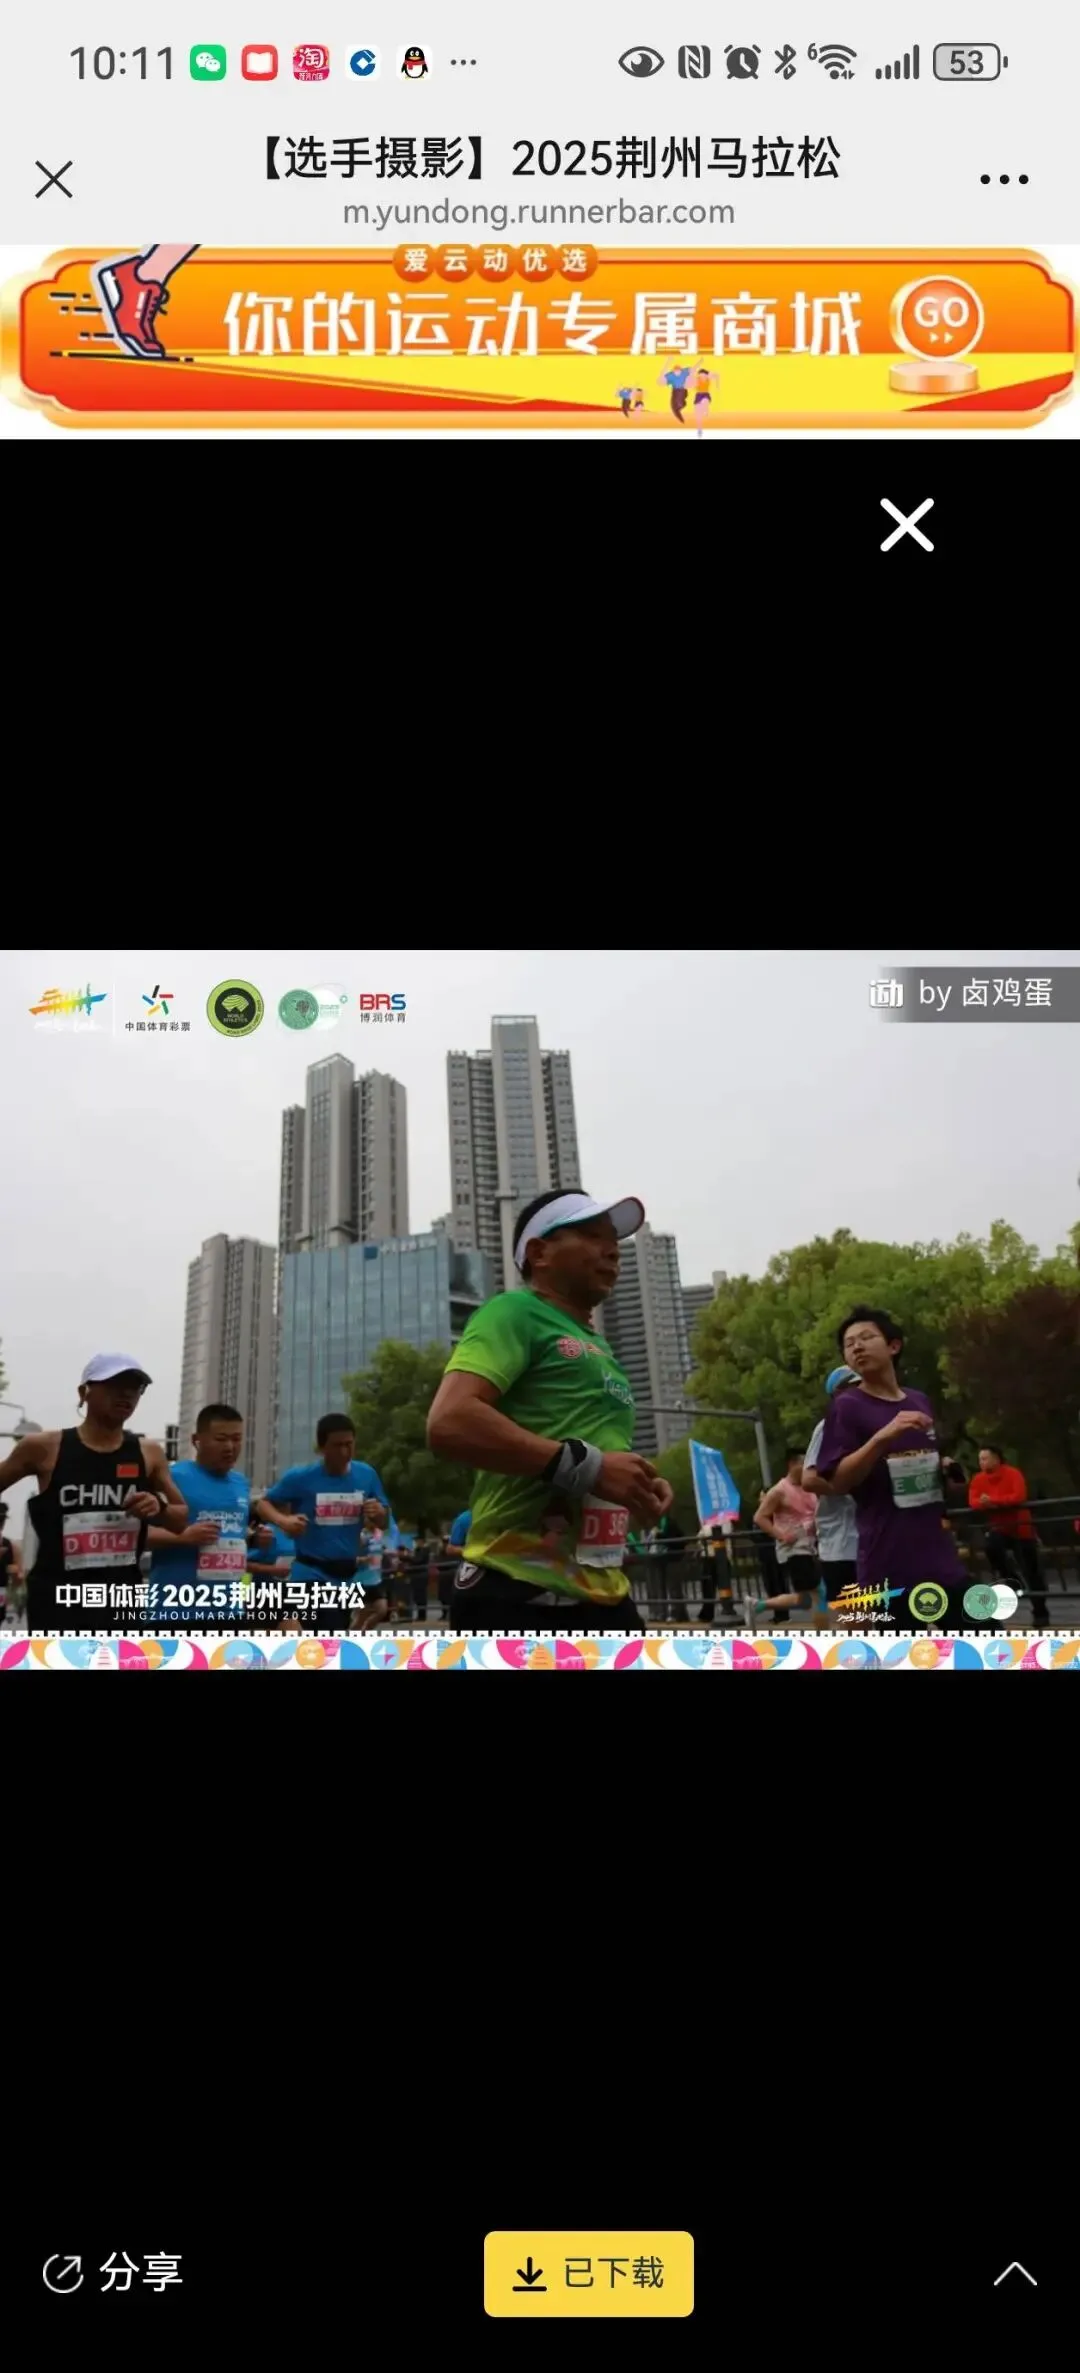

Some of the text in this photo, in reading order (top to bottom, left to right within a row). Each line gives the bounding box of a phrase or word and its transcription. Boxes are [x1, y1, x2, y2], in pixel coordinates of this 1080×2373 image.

[70, 46, 172, 80] 10:11
[950, 49, 985, 76] 53
[265, 134, 842, 181] 【选手摄影】2025荆州马拉松
[343, 197, 735, 231] m.yundong.runnerbar.com
[403, 248, 588, 272] 爱云动优选
[223, 291, 862, 357] 你的运动专属商城
[914, 295, 970, 328] GO
[65, 1532, 130, 1553] D 0114
[584, 1514, 600, 1540] D
[98, 2250, 184, 2293] 分享
[564, 2255, 665, 2289] 已下载
